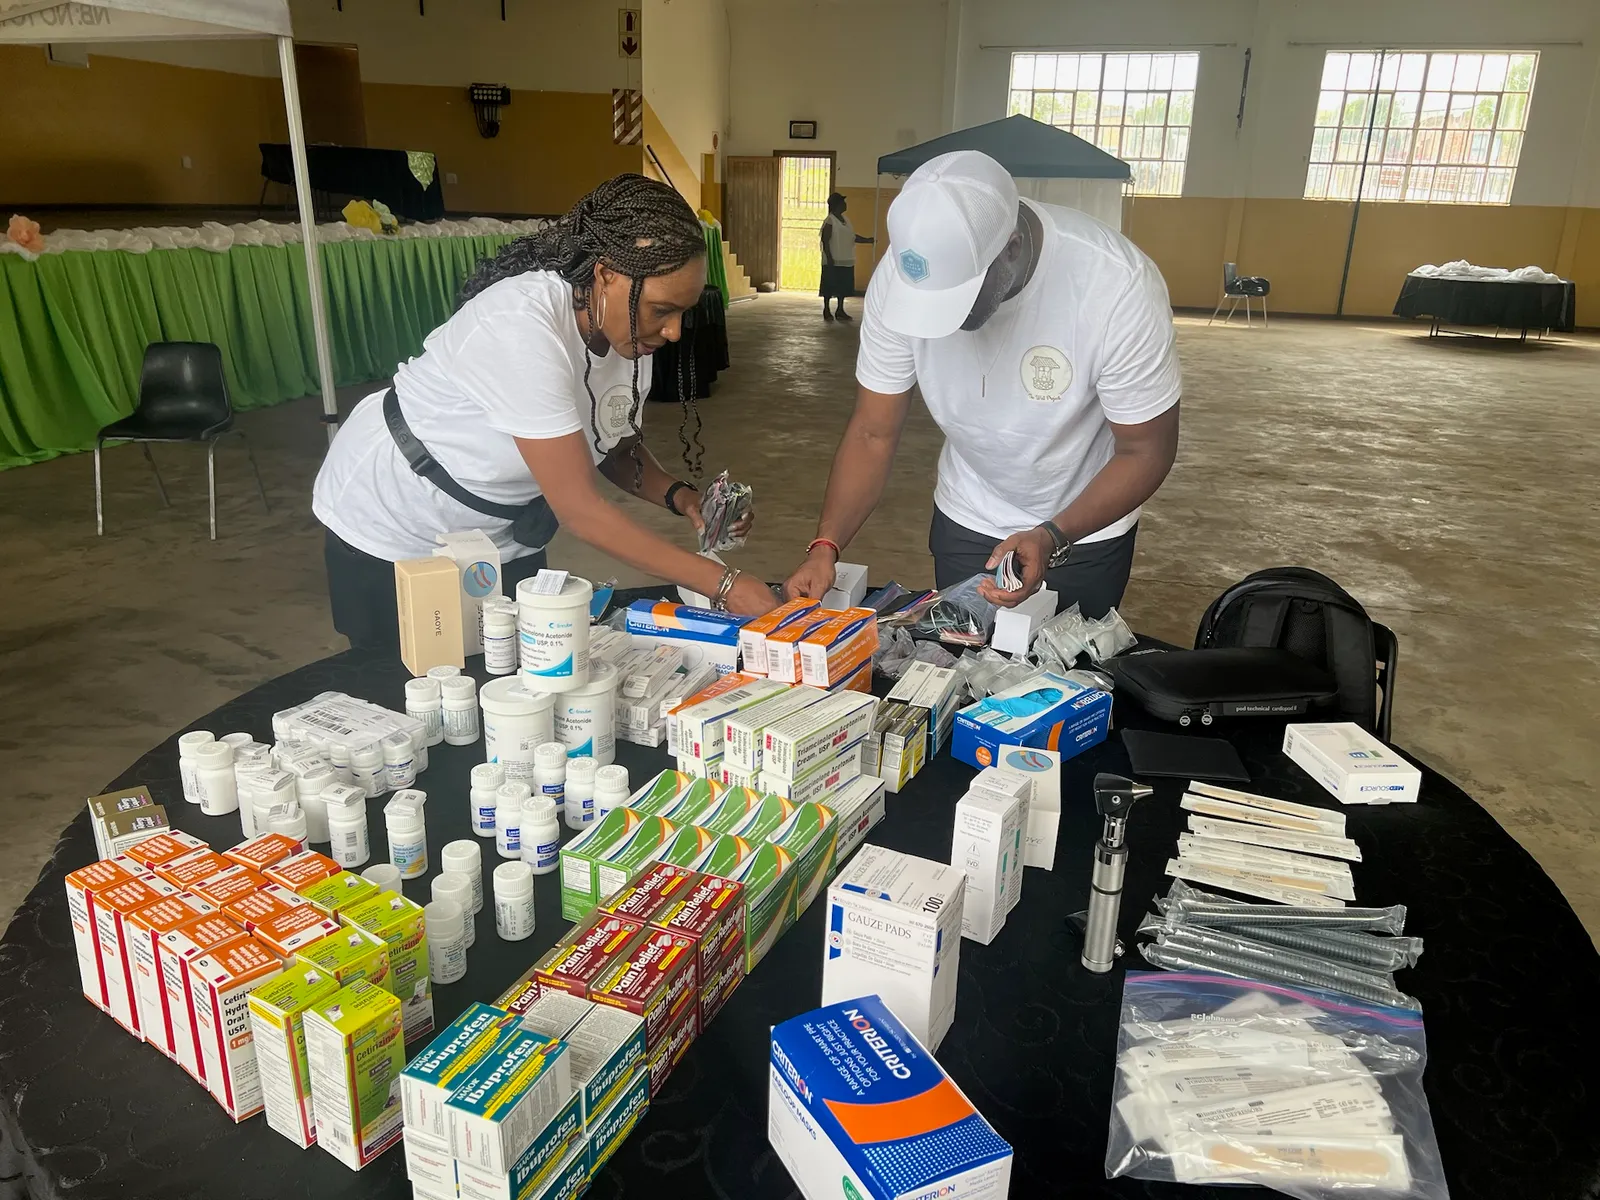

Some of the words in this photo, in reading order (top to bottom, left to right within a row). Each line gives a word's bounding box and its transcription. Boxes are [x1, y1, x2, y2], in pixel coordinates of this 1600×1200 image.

[434, 610, 442, 637] GAOYE
[545, 632, 573, 640] Acetonide
[1272, 705, 1294, 713] cardiopod
[797, 728, 839, 757] Triamcinolone
[839, 713, 867, 732] Acetonide
[956, 716, 982, 732] CRITERION
[1075, 726, 1098, 742] CRITERION
[796, 751, 817, 768] Cream,
[818, 742, 830, 754] USP
[793, 771, 831, 799] Triamcinolone
[831, 754, 856, 773] Acetonide
[618, 891, 640, 913] Pain
[639, 872, 663, 895] Relief
[670, 904, 693, 927] Pain
[687, 885, 712, 910] Relief
[922, 896, 944, 914] 100
[848, 911, 885, 932] GAUZE
[885, 923, 912, 940] PADS
[308, 943, 338, 959] Cetirizine
[388, 936, 420, 958] etirizine
[556, 952, 581, 974] Pain
[581, 927, 608, 953] Relief
[612, 969, 634, 994] Pain
[631, 943, 661, 972] Relief
[264, 981, 295, 1000] Cetirizine
[511, 987, 534, 1011] Pain
[226, 1014, 245, 1026] Oral
[228, 1023, 248, 1036] USP,
[803, 1022, 817, 1035] PPE
[420, 1012, 491, 1073] Ibuprofen
[816, 1023, 836, 1042] RIGHT
[827, 1019, 855, 1049] PRACTICE
[356, 1033, 396, 1062] Cetirizine
[812, 1034, 834, 1056] SMART
[831, 1041, 849, 1057] JUST
[413, 1050, 436, 1070] MAJOR
[829, 1055, 841, 1066] OF
[851, 1047, 869, 1068] YOUR
[464, 1039, 534, 1105] Ibuprofen
[591, 1040, 641, 1102] Ibuprofen
[837, 1065, 860, 1091] RANGE
[844, 1056, 872, 1088] OPTIONS
[865, 1066, 881, 1082] FOR
[457, 1078, 480, 1101] MAJOR
[772, 1070, 797, 1109] EARLOOP
[796, 1107, 817, 1141] MASKS
[1226, 1107, 1264, 1118] DEPRESSORS
[595, 1088, 645, 1151] Ibuprofen
[516, 1146, 536, 1171] MAJOR
[517, 1113, 576, 1184] Ibuprofen
